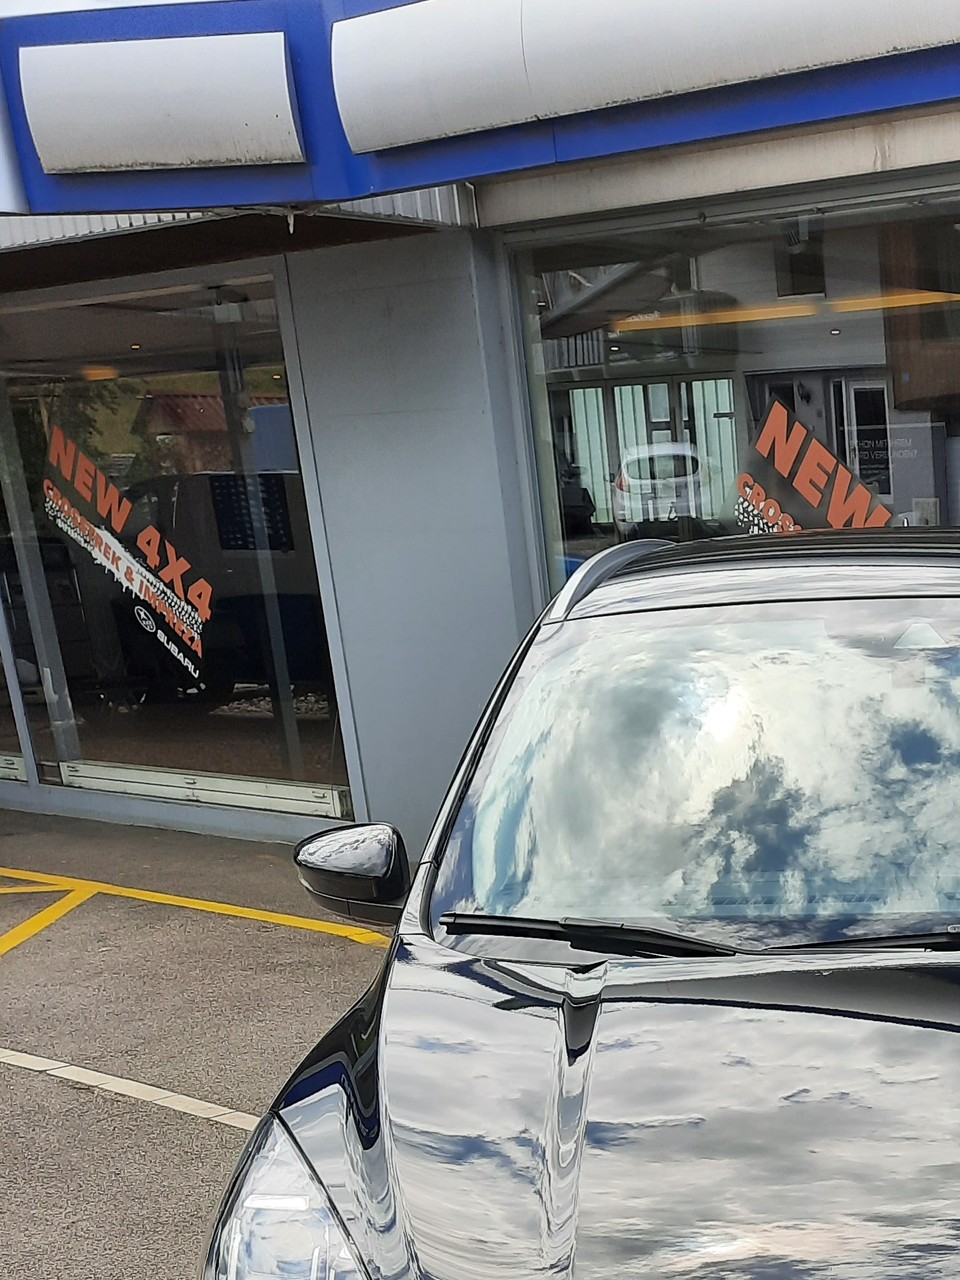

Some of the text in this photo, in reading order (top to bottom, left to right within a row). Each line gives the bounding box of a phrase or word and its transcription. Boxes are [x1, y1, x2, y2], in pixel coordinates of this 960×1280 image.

[49, 424, 133, 534] NEW
[737, 472, 802, 533] CROS
[755, 400, 893, 529] NEW
[137, 577, 203, 660] IMPREZA
[156, 629, 200, 679] SUBARU
